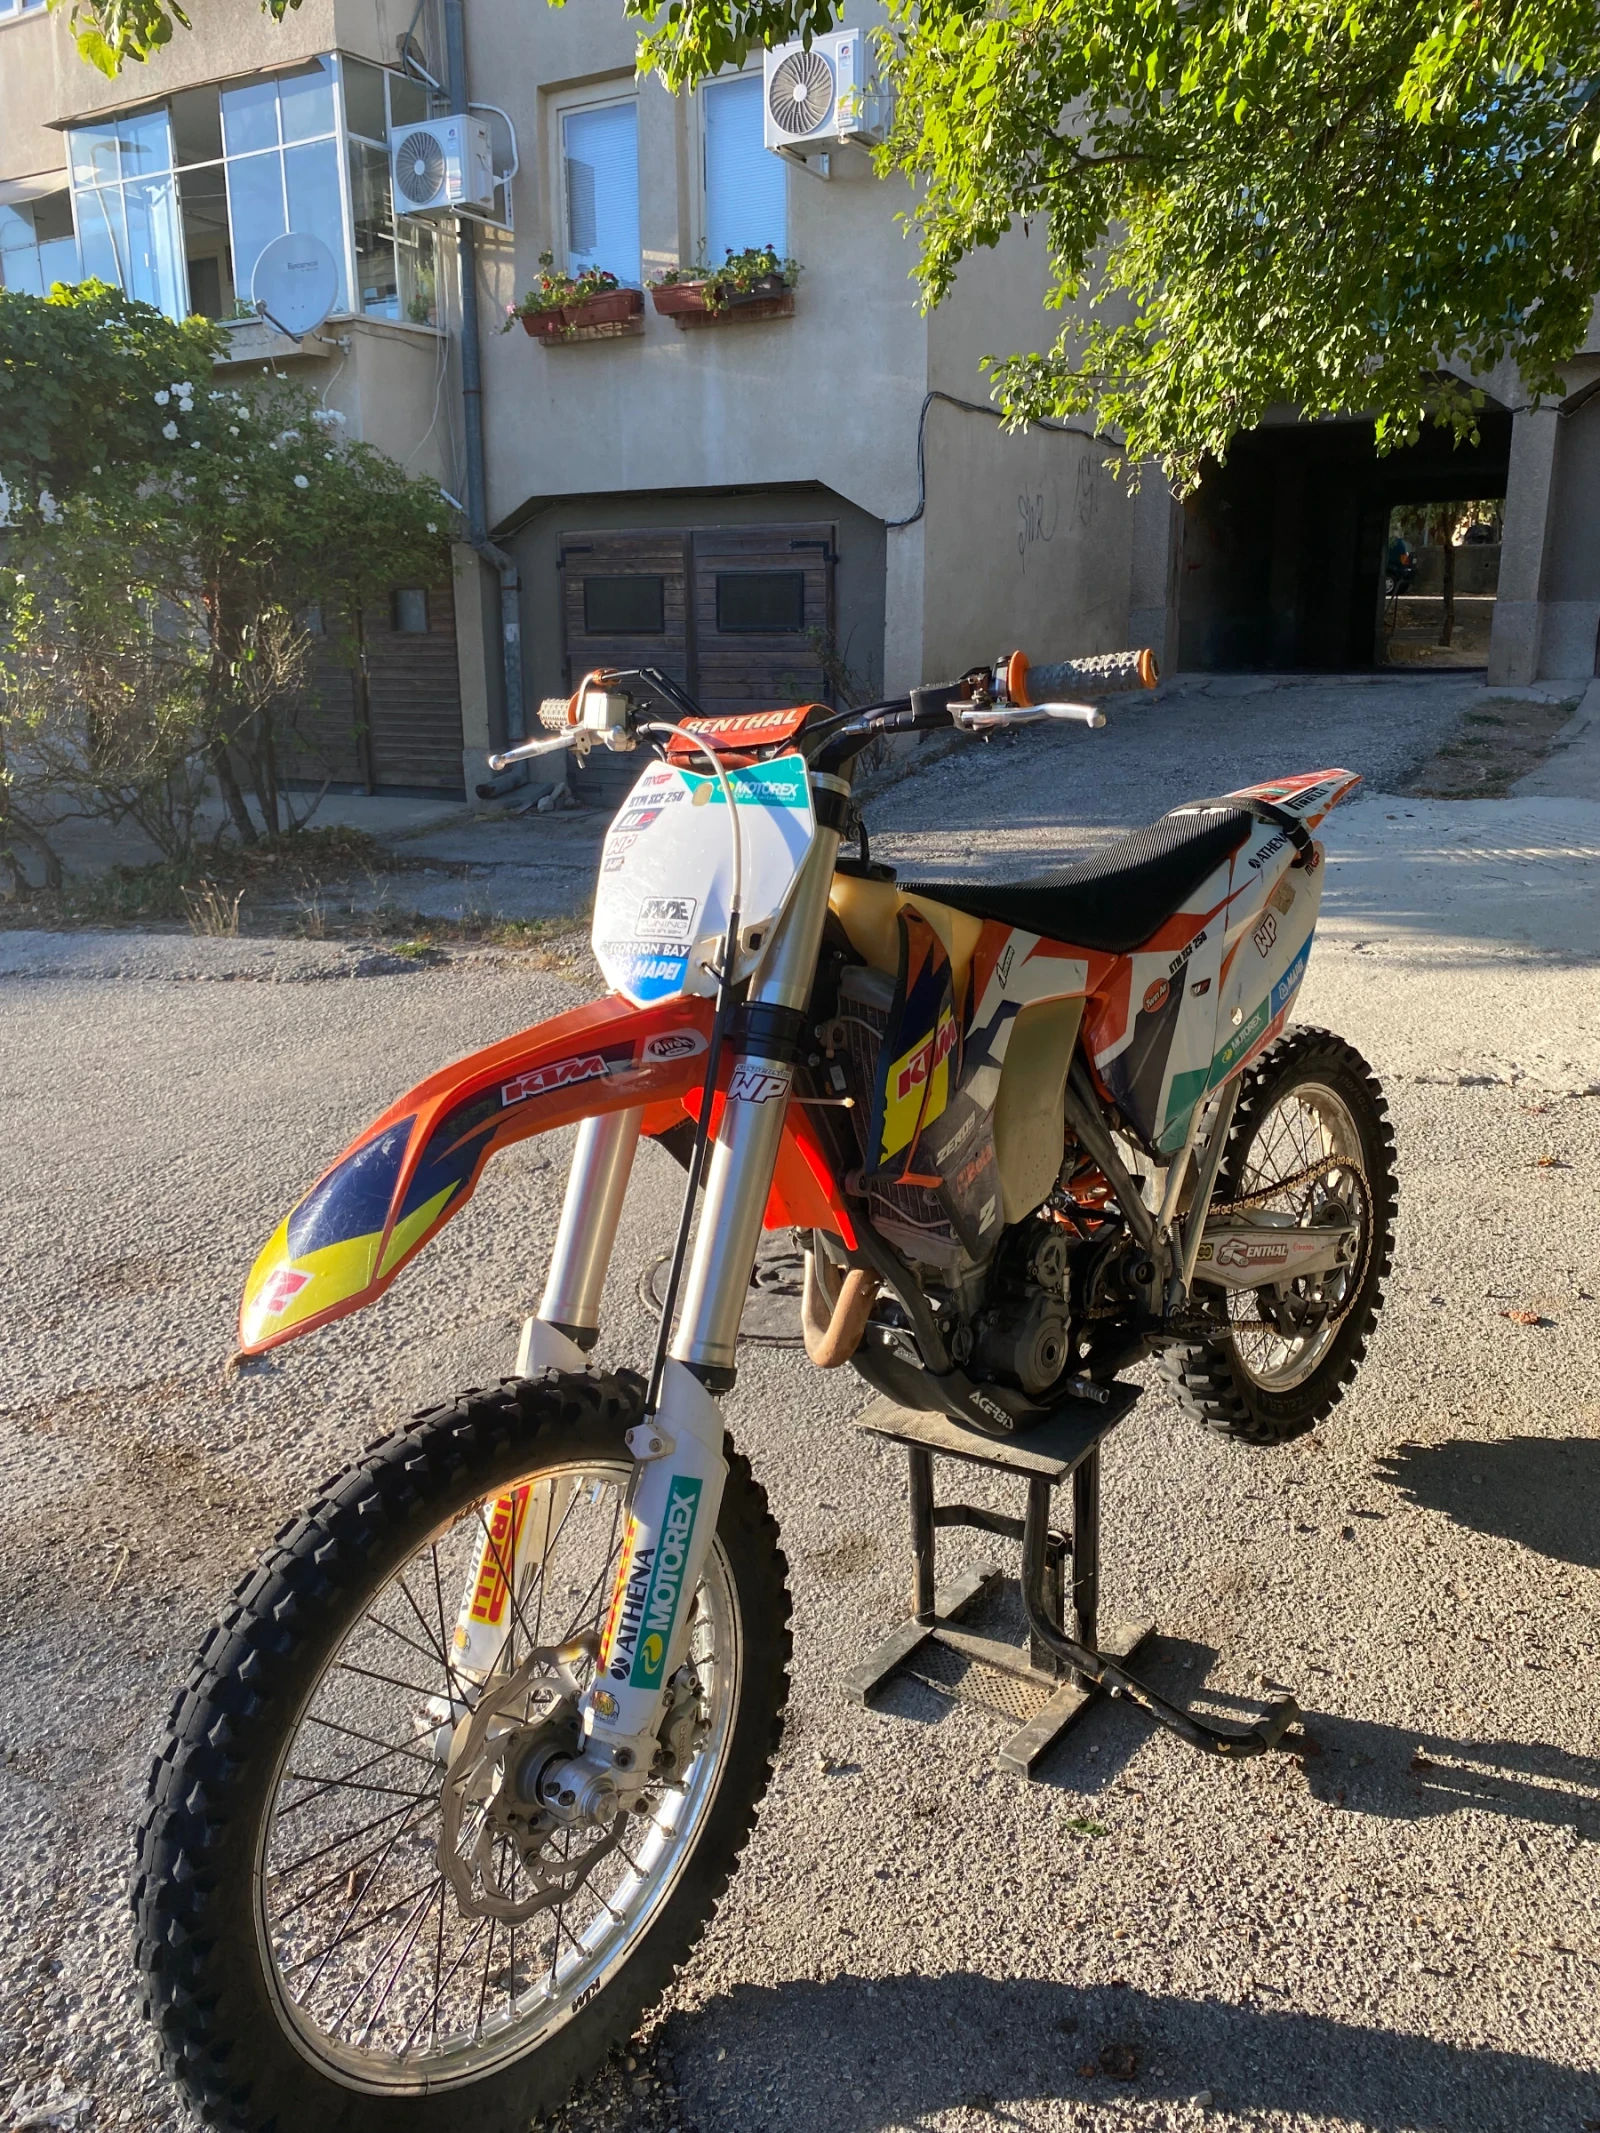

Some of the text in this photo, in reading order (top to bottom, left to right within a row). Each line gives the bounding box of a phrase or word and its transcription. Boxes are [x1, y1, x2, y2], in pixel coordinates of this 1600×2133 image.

[685, 710, 798, 734] RENTHAL
[641, 773, 674, 787] MXGP
[734, 780, 800, 797] MOTOREX
[628, 795, 649, 808] KTM
[664, 791, 686, 804] 250
[1281, 787, 1329, 811] PIRELLI
[605, 834, 639, 856] WP
[1256, 831, 1289, 863] ATHENA
[640, 920, 688, 929] TUNING
[1254, 913, 1277, 958] WP
[662, 944, 691, 958] BAY
[1169, 958, 1183, 975] KTM
[1193, 930, 1208, 949] 250
[633, 960, 682, 981] MAPEI
[1286, 958, 1305, 989] MAPEI
[1145, 983, 1168, 1009] Twin Air
[654, 1037, 695, 1055] Airoh
[1231, 1013, 1262, 1050] MOTOREX
[897, 1014, 958, 1102] KTM
[503, 1056, 610, 1106] KTM
[727, 1071, 789, 1104] WP
[969, 1389, 1015, 1430] ACERBIS
[646, 1491, 697, 1632] MOTOREX
[616, 1548, 655, 1656] ATHENA
[571, 1976, 600, 2014] KTM
